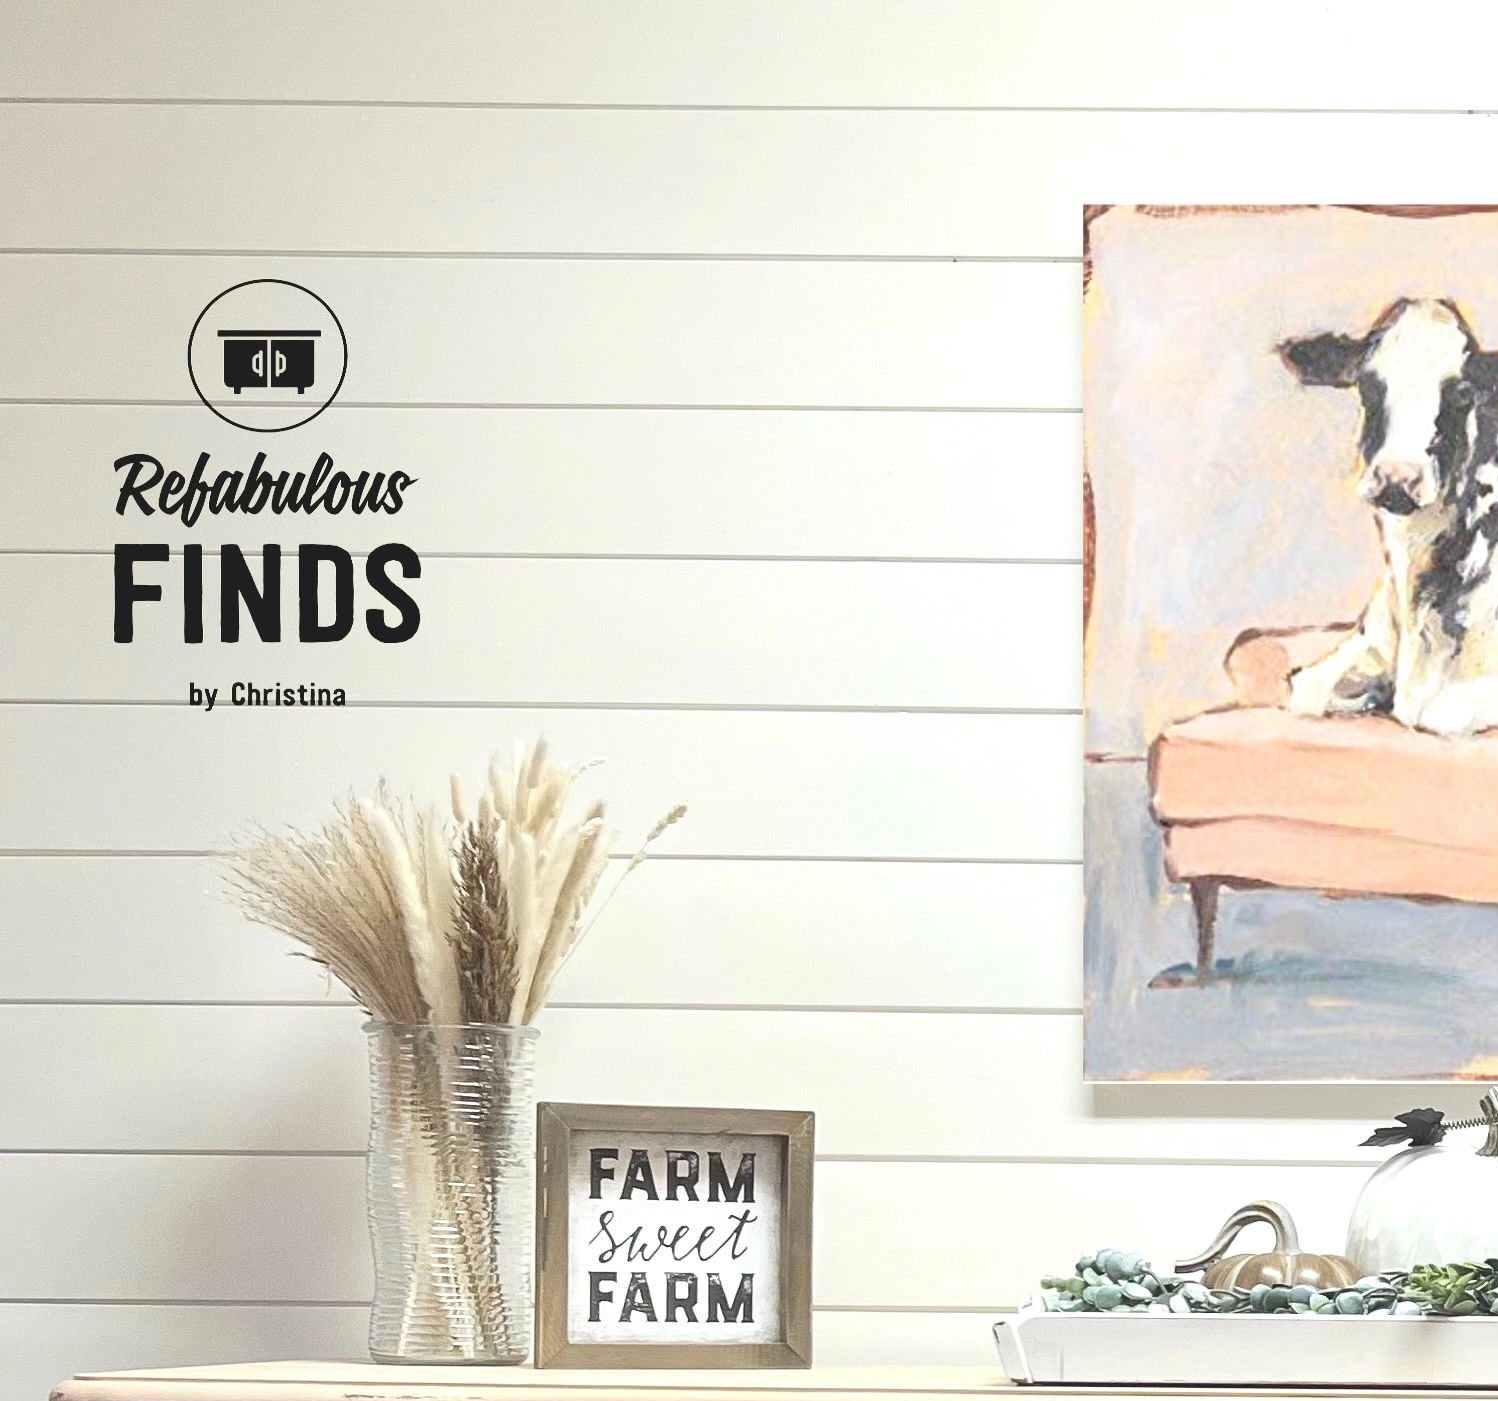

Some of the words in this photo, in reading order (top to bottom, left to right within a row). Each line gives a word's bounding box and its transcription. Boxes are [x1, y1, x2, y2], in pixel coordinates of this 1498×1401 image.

[588, 1148, 756, 1203] FARM
[589, 1209, 758, 1263] sweet
[587, 1271, 755, 1323] FARM
